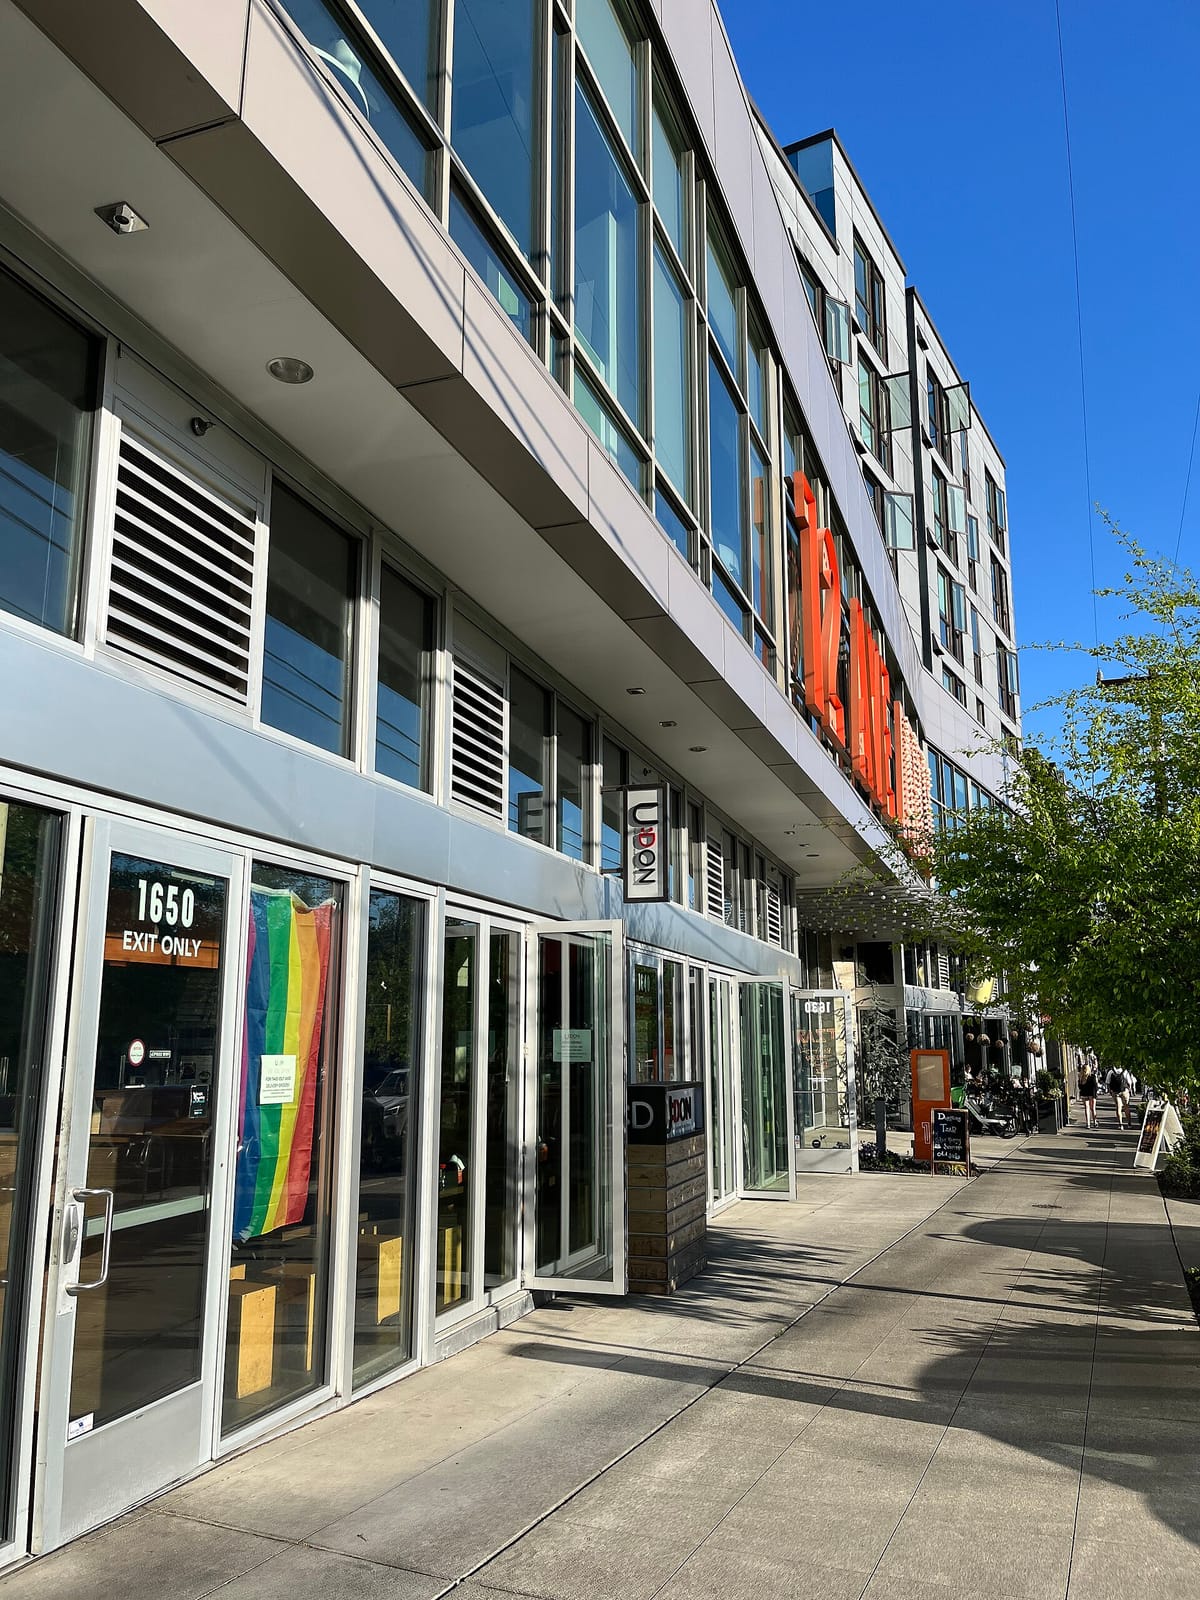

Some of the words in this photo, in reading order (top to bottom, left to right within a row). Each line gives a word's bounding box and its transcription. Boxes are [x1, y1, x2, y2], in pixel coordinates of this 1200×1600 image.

[137, 879, 195, 928] 1650
[122, 930, 158, 953] EXIT
[161, 935, 202, 958] ONLY
